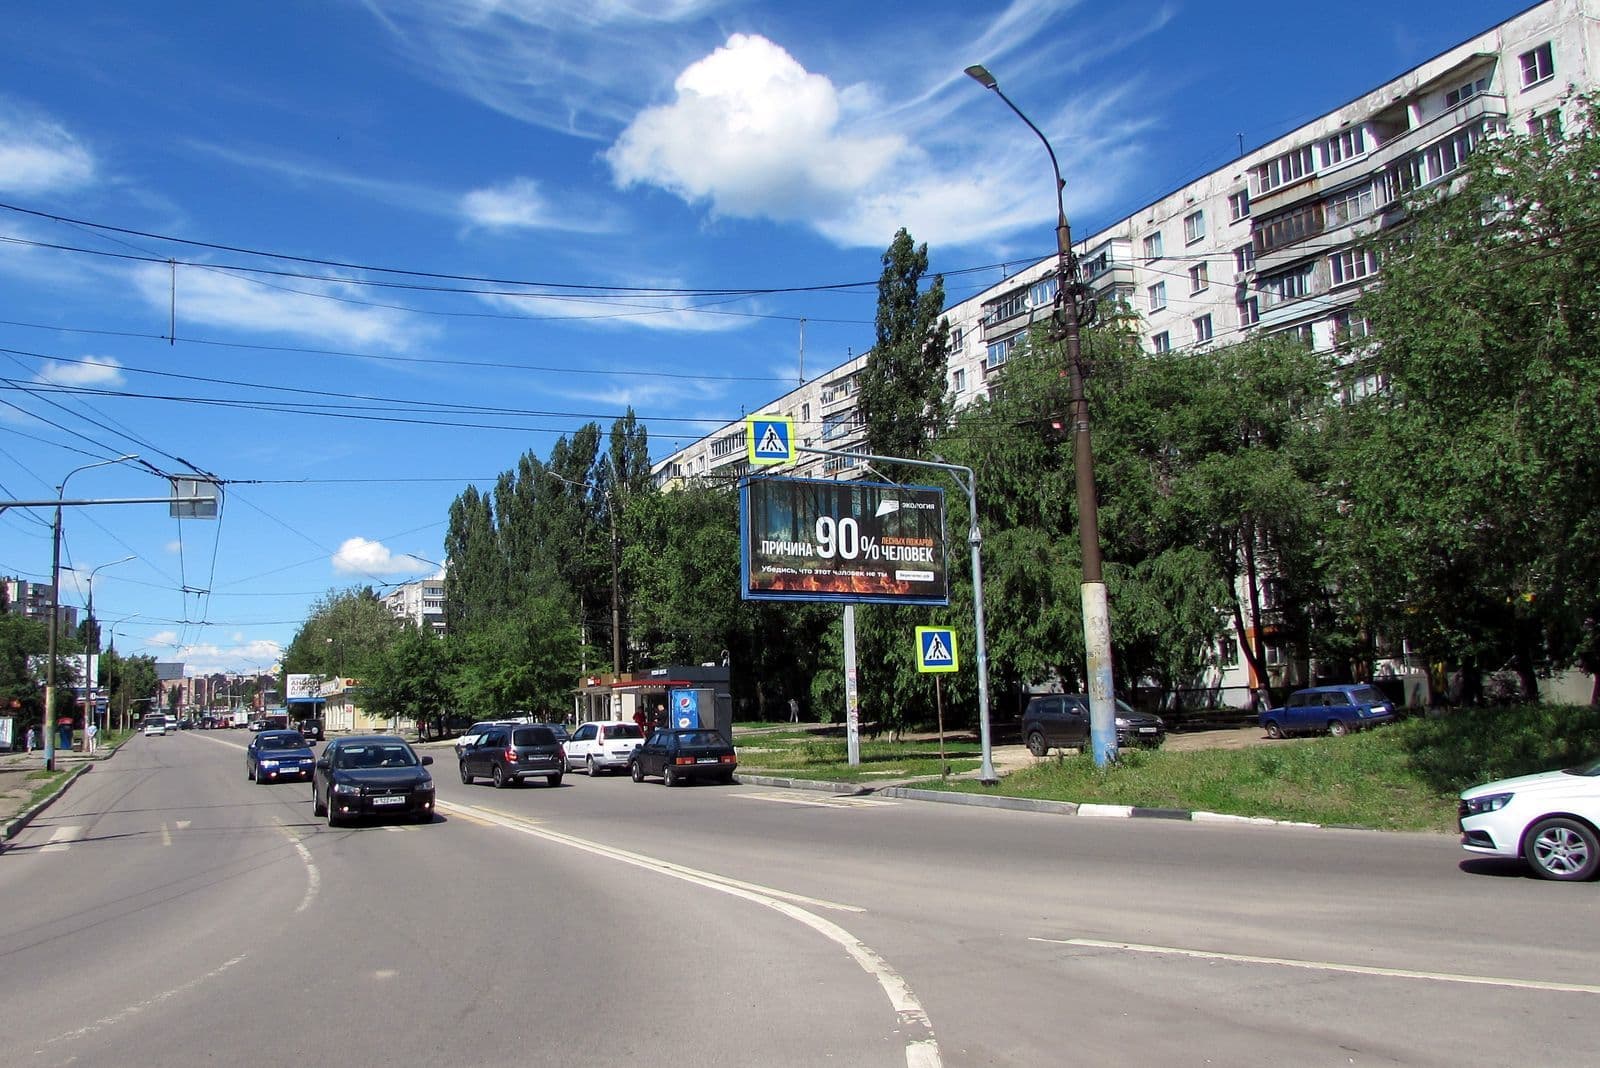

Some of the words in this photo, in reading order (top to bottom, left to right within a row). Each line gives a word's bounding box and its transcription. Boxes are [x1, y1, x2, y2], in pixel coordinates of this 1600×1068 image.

[881, 536, 905, 546] ЛЕСНЫХ
[762, 540, 813, 557] ПРИЧИНА
[881, 545, 934, 562] ЧЕЛОВЕК
[761, 565, 798, 575] Убедись,
